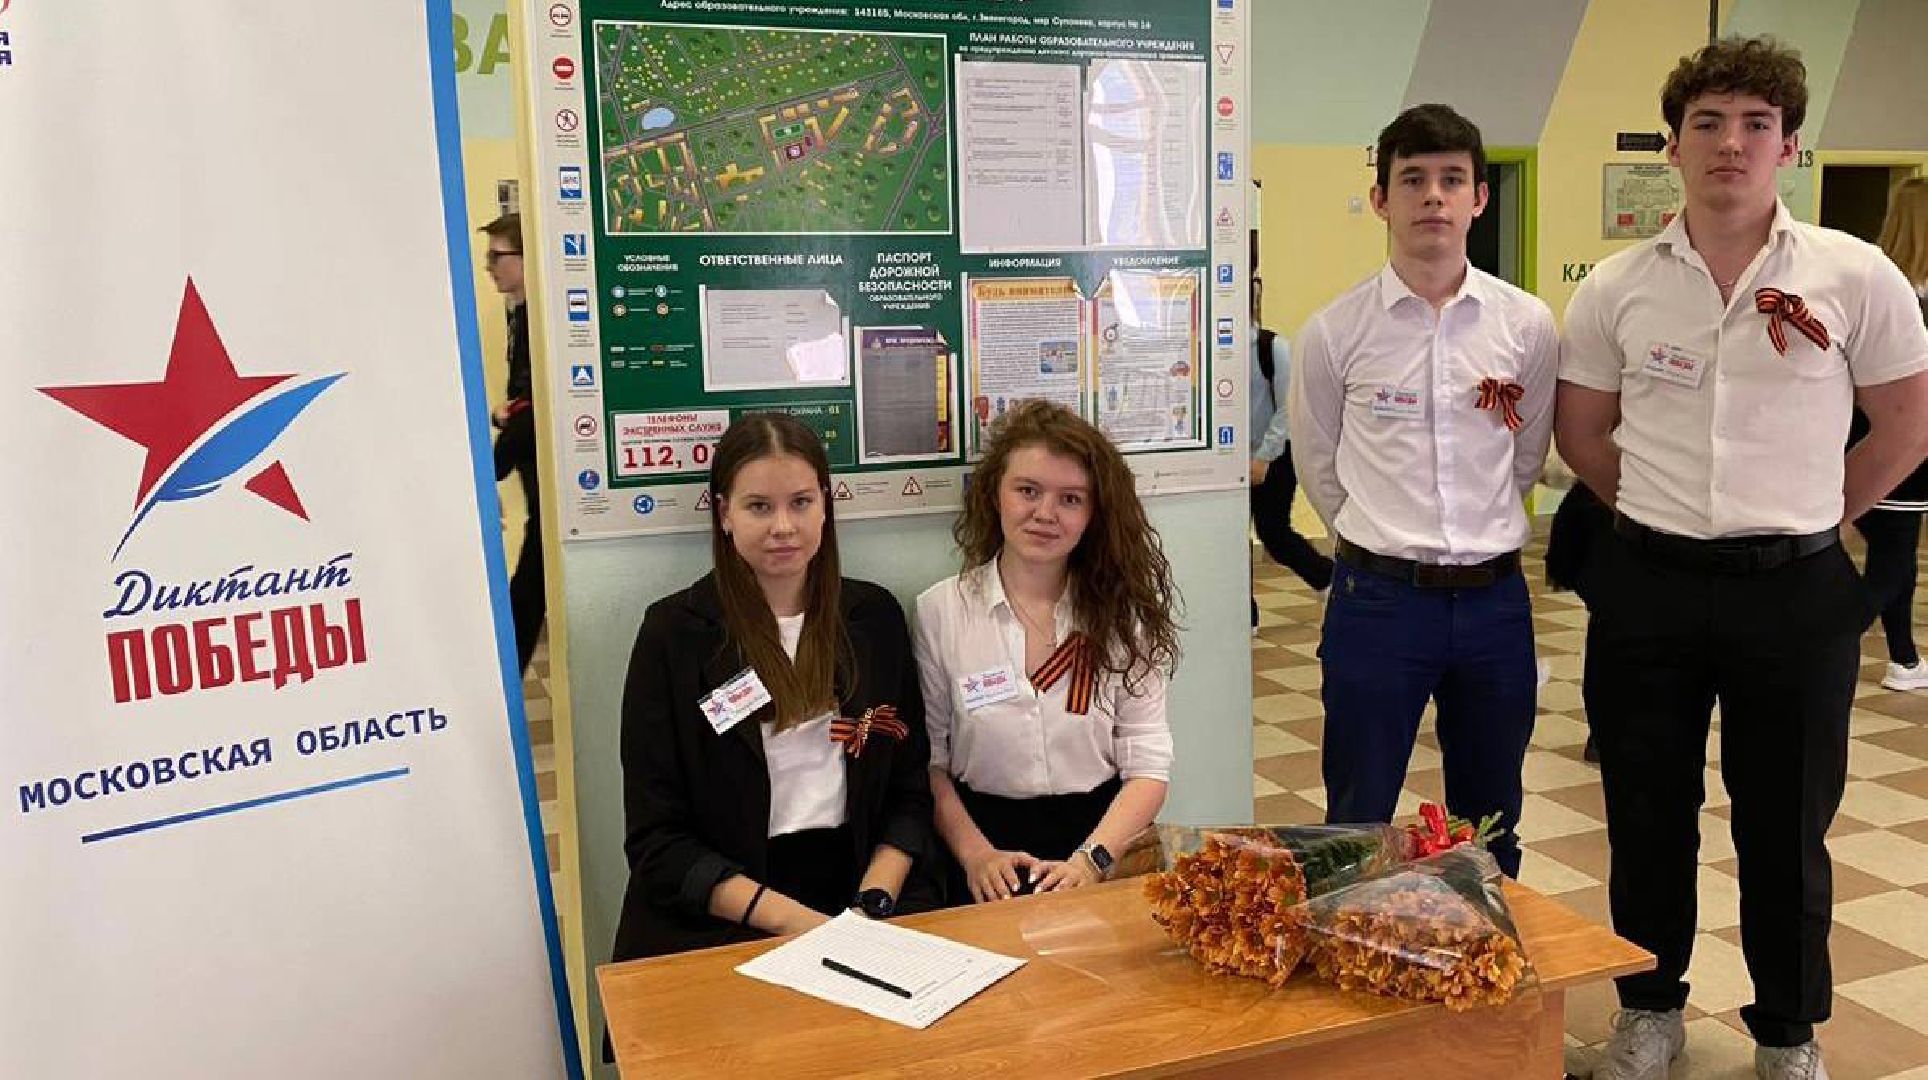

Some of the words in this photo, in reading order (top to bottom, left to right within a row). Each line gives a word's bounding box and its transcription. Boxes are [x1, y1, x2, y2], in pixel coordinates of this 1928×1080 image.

[969, 32, 997, 43] ПЛАН
[999, 34, 1037, 45] РАБОТЫ
[1038, 36, 1134, 48] ОБРАЗОВАТЕЛЬНОГО
[1136, 40, 1195, 51] УЧРЕЖДЕНИЯ
[1797, 150, 1813, 167] 13
[699, 254, 804, 265] ОТВЕТСТВЕННЫЕ
[807, 254, 844, 266] ЛИЦА
[877, 252, 932, 264] ПАСПОРТ
[988, 257, 1062, 269] ИНФОРМАЦИЯ
[869, 263, 940, 280] ДОРОЖНОЙ
[1562, 263, 1596, 282] КА
[858, 279, 953, 293] БЕЗОПАСНОСТИ
[623, 444, 683, 469] 112,
[692, 443, 718, 464] 0
[103, 552, 354, 618] Диктант
[106, 597, 368, 704] ПОБЕДЫ
[19, 737, 273, 813] МОСКОВСКАЯ
[296, 707, 449, 756] ОБЛАСТЬ
